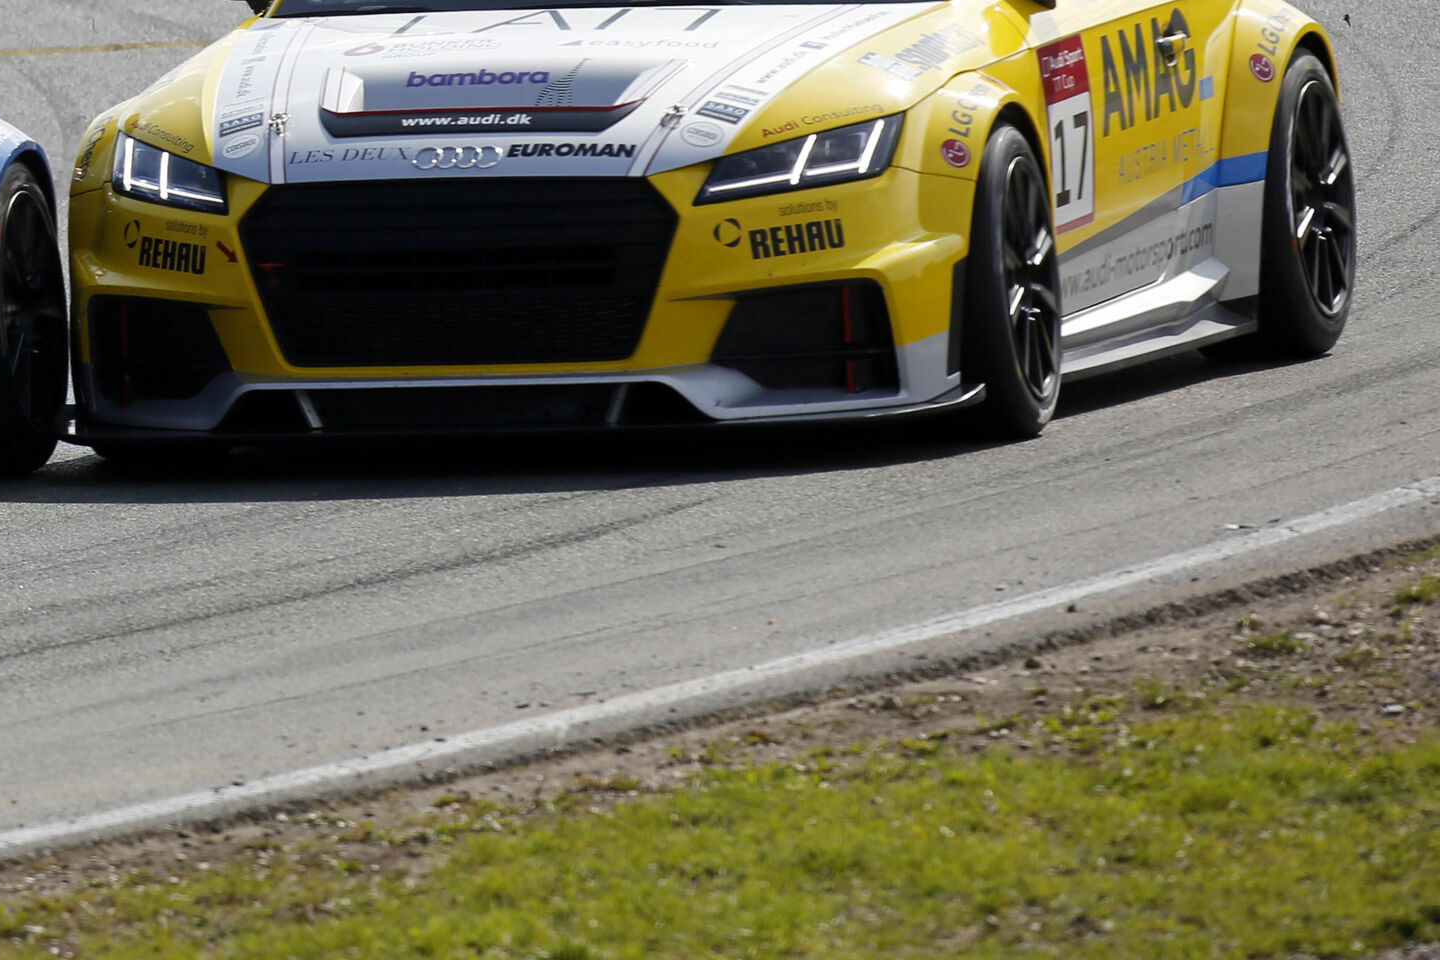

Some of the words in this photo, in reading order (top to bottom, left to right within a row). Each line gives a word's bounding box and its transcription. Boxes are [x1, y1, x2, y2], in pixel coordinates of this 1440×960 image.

[406, 68, 550, 88] bambora
[1100, 8, 1197, 138] AMAG
[401, 112, 533, 128] www.audi.dk
[762, 121, 800, 138] Audi
[801, 102, 885, 126] Consulting
[288, 149, 336, 165] LES
[343, 147, 409, 162] DEUX
[506, 143, 636, 159] EUROMAN
[1054, 110, 1088, 208] 17
[779, 200, 823, 217] solutions
[824, 198, 838, 213] by
[748, 218, 846, 260] REHAU
[139, 236, 207, 275] REHAU
